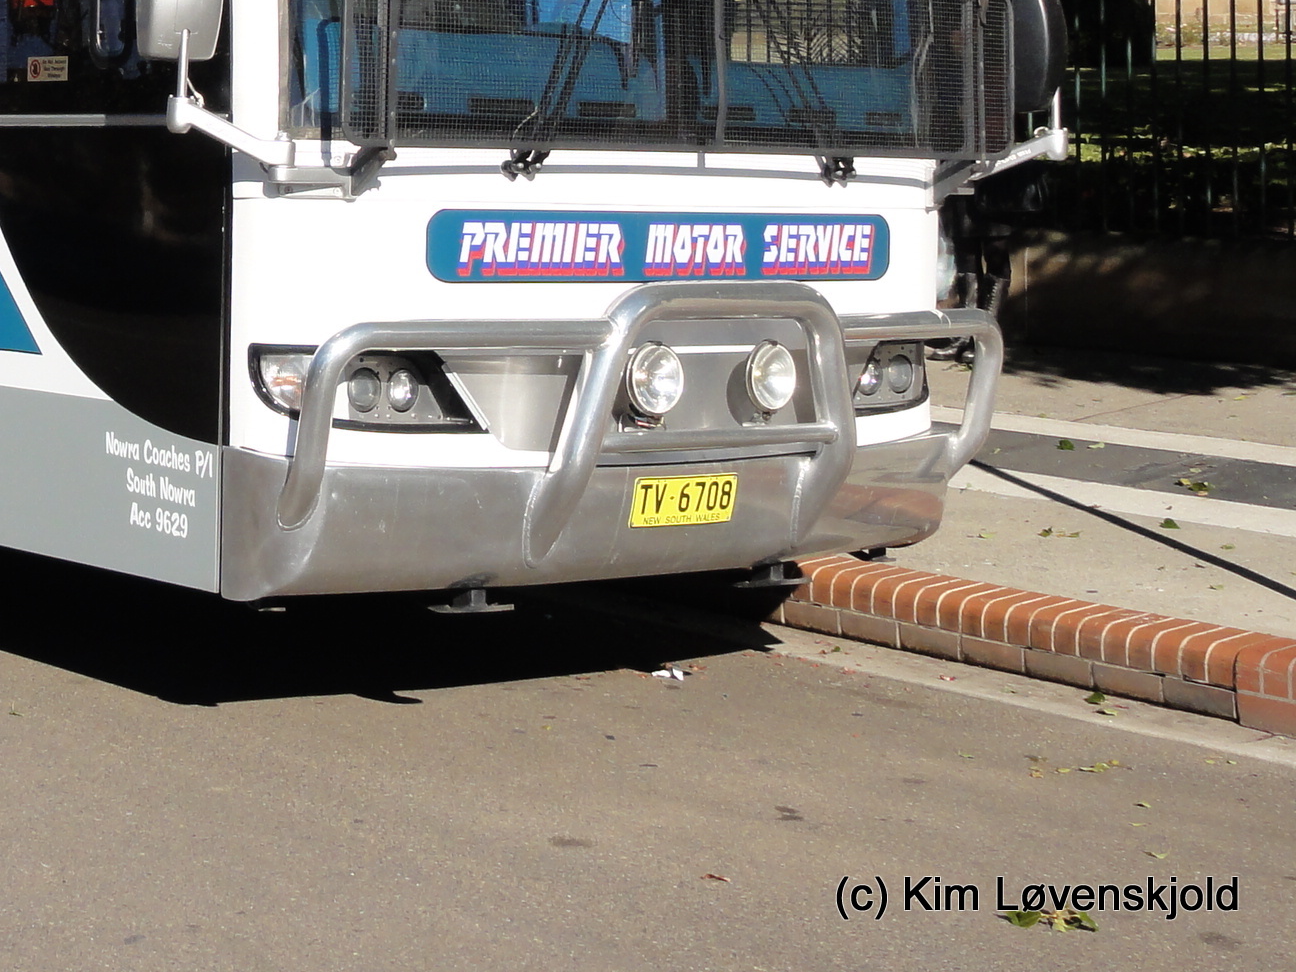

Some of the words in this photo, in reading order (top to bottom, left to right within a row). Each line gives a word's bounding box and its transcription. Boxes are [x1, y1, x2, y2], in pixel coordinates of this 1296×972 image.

[456, 220, 625, 276] PREMIER
[643, 223, 747, 276] MOTOR
[761, 224, 875, 276] SERVICE
[105, 431, 140, 461] Nowra
[143, 439, 191, 472] Coaches
[126, 467, 157, 498] South
[160, 476, 196, 507] Nowra
[130, 502, 151, 529] Acc
[155, 507, 188, 539] 9629
[642, 517, 662, 525] NEW
[665, 515, 692, 524] SOUTH
[696, 513, 721, 522] WALES
